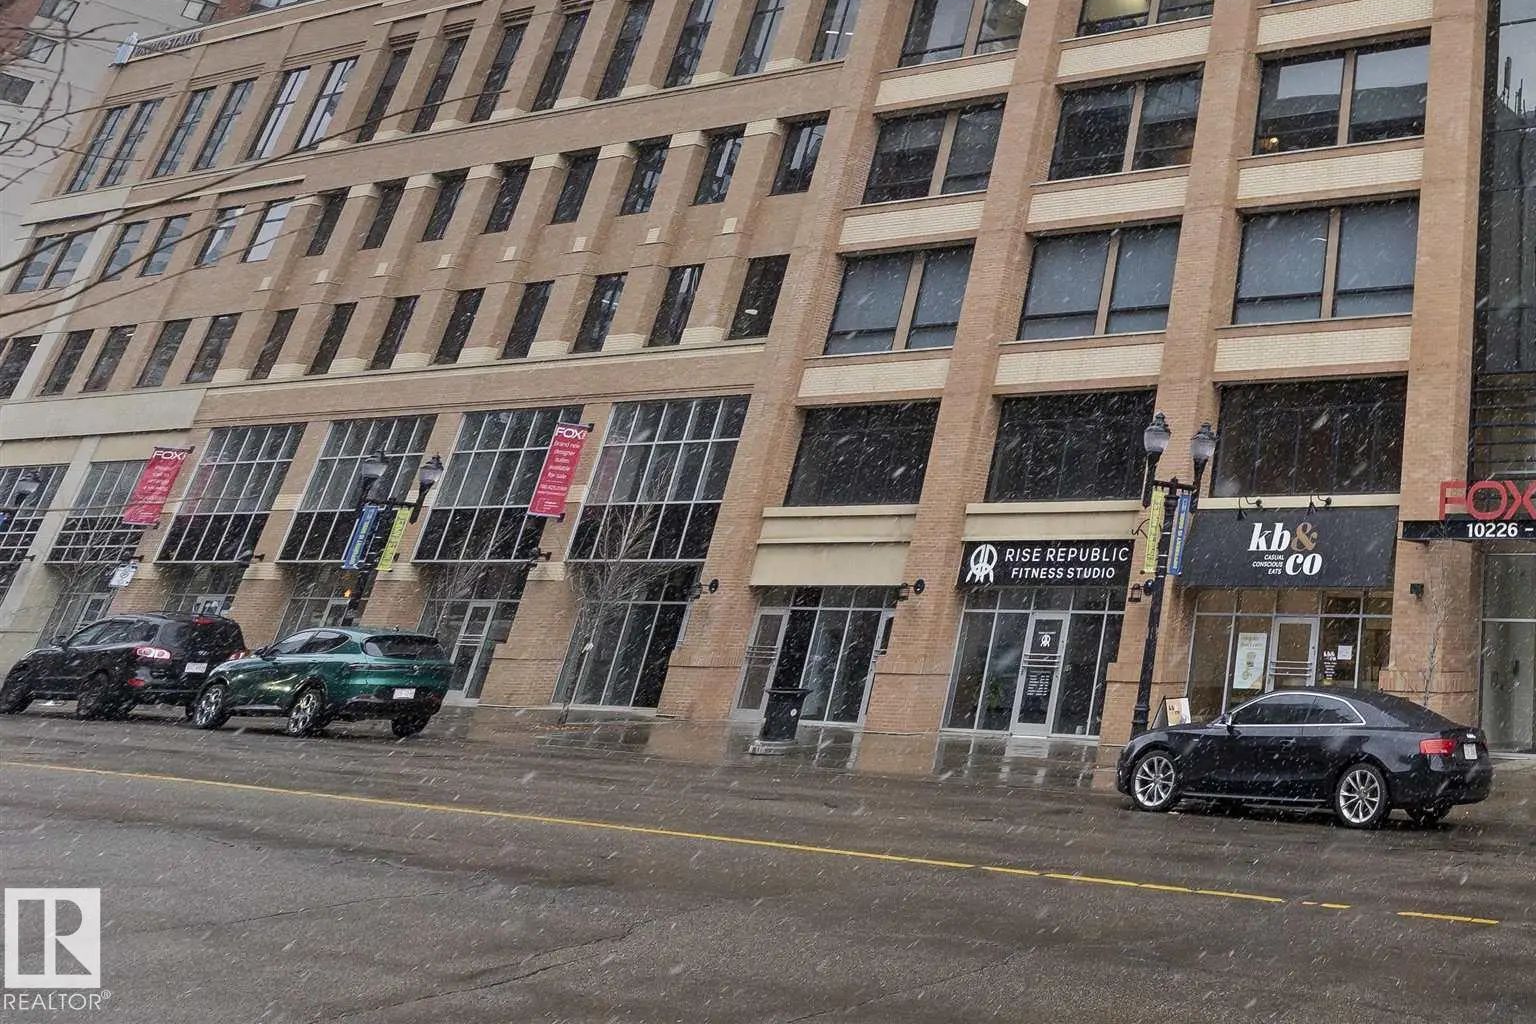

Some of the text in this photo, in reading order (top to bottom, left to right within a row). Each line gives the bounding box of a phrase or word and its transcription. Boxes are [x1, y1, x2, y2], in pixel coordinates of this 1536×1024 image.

[1466, 522, 1518, 538] 10226
[1004, 547, 1130, 562] RISE REPUBLIC
[1011, 567, 1115, 579] FITNESS STUDIO
